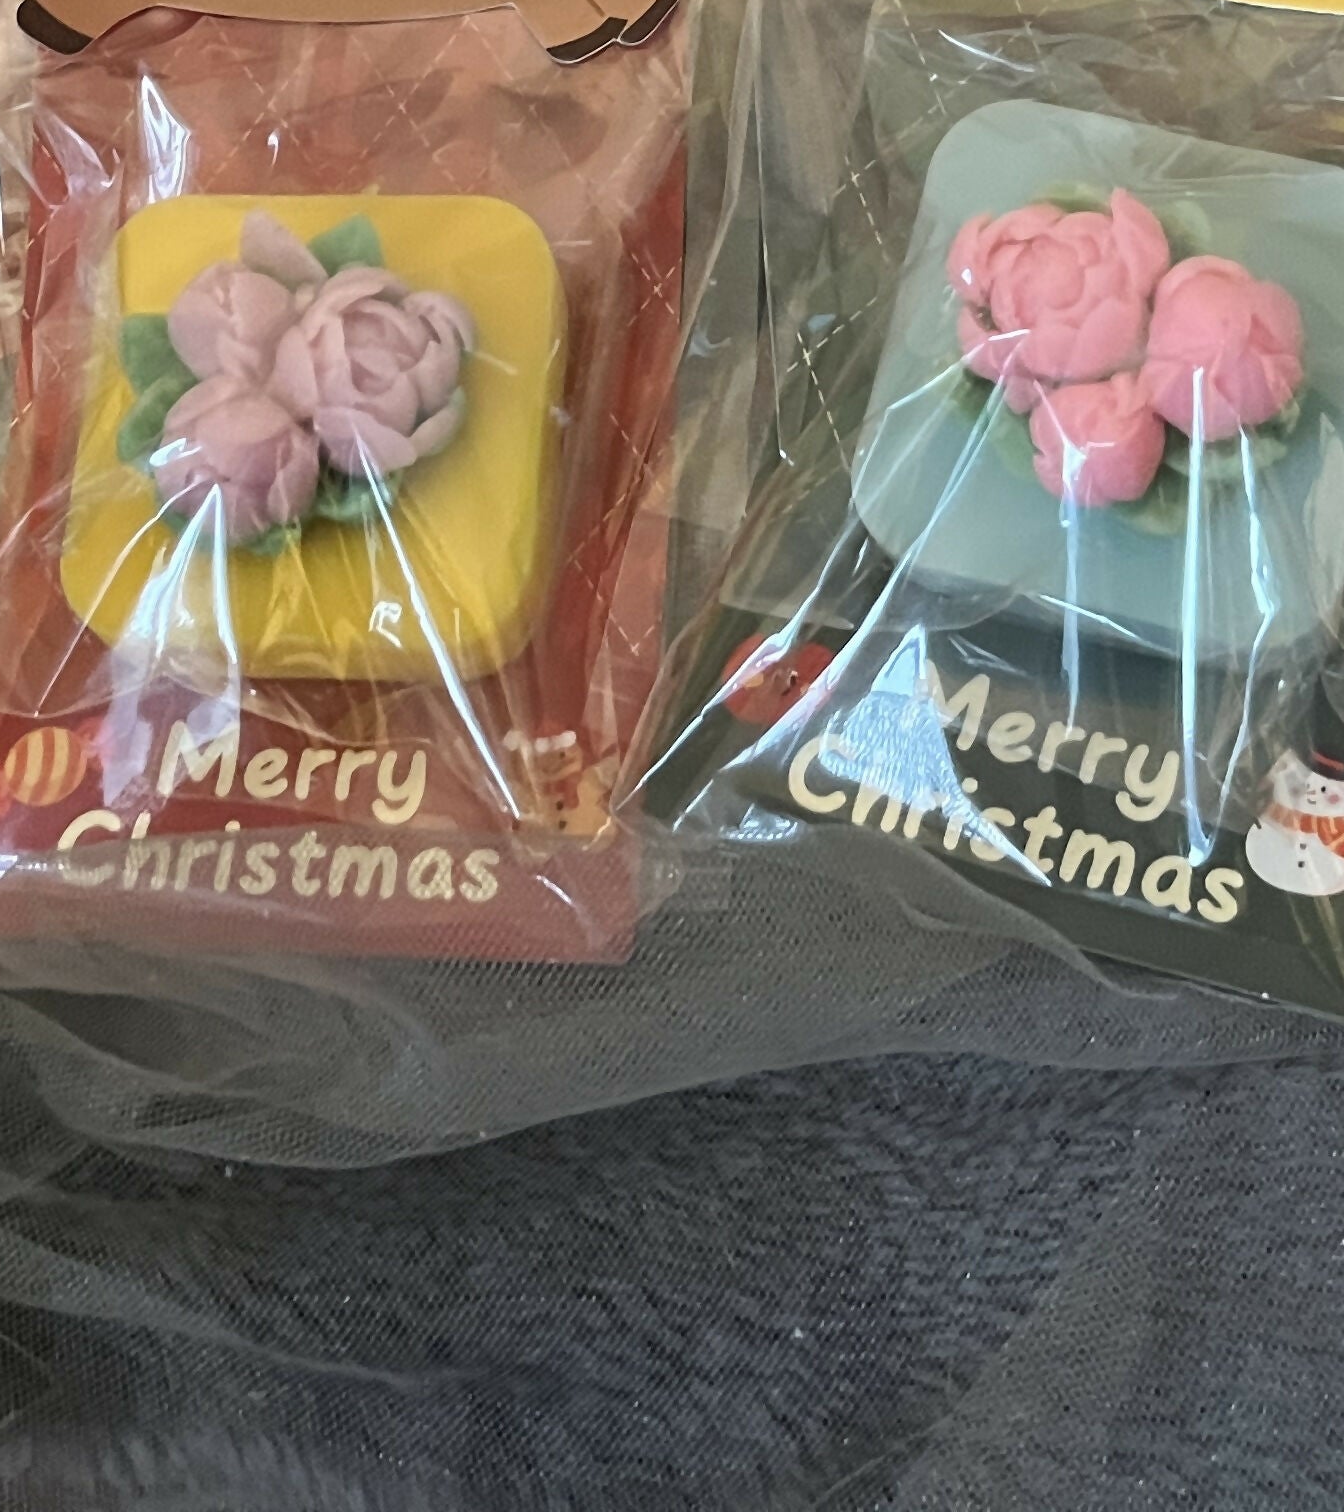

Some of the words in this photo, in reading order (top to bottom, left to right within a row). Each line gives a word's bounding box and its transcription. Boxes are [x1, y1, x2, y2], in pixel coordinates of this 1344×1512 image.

[160, 719, 427, 825] Merry
[916, 657, 1177, 821] Merry
[58, 811, 500, 902] Christmas
